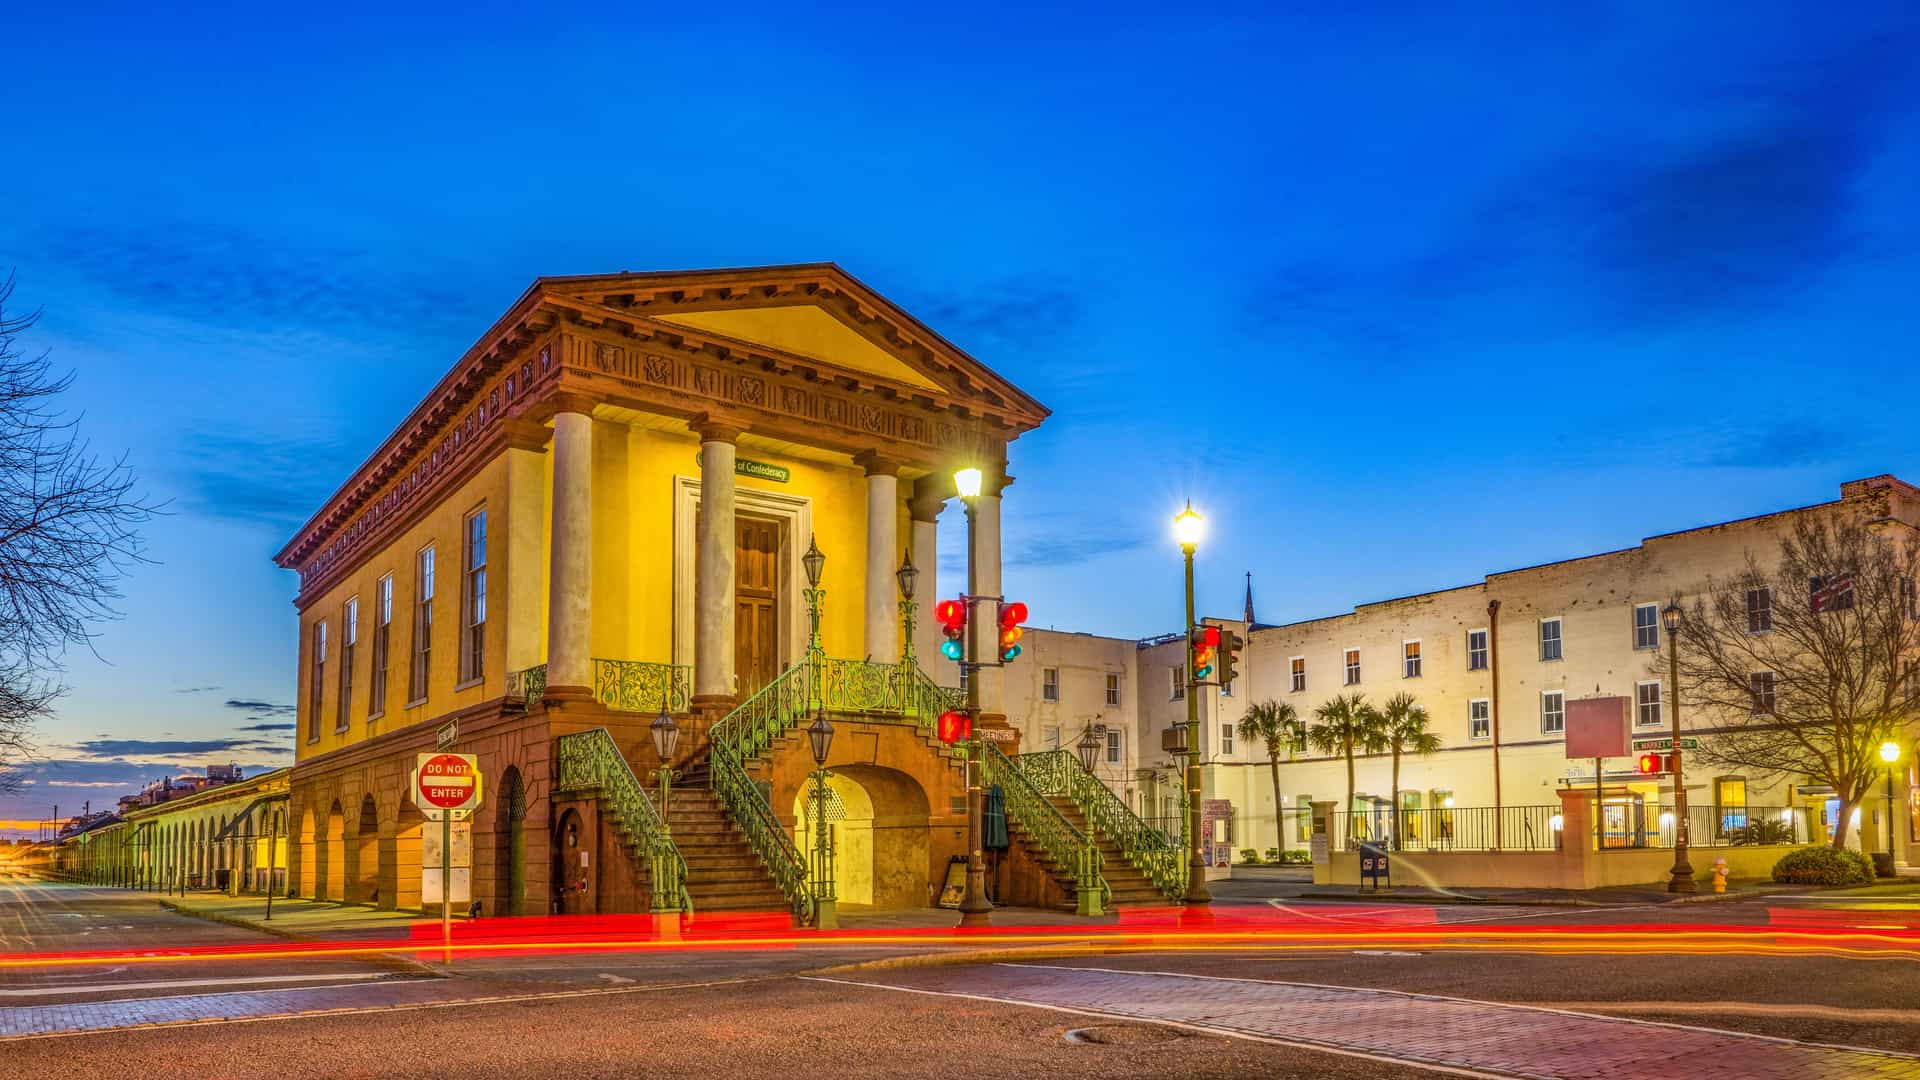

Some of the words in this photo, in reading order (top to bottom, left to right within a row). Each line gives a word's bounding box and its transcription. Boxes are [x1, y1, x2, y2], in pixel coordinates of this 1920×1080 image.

[738, 462, 746, 471] of
[746, 462, 785, 480] Confederacy
[427, 764, 442, 774] DO
[447, 764, 468, 774] NOT
[431, 788, 464, 798] ENTER
